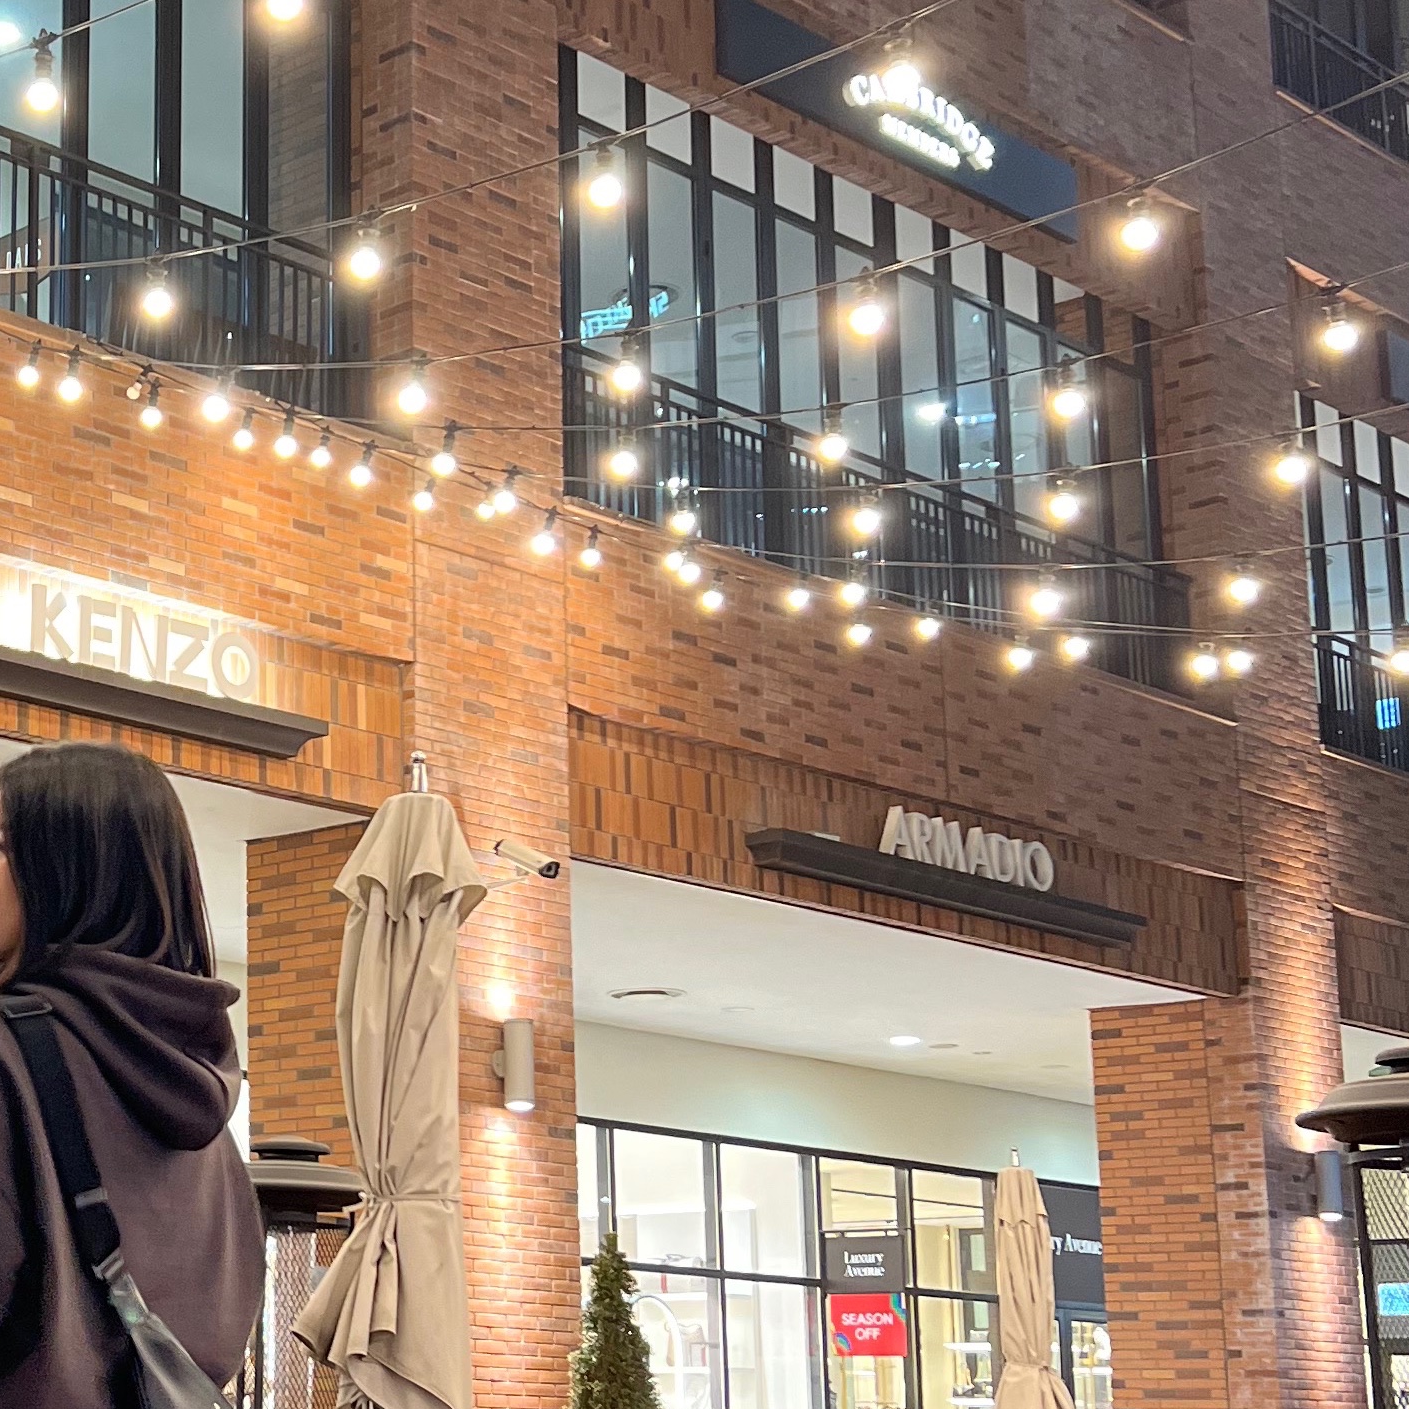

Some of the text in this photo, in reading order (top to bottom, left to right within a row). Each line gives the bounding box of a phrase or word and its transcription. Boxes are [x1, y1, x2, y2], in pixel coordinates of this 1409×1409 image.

[30, 583, 259, 700] KENZO
[878, 804, 1055, 893] ARMADIO
[843, 1250, 885, 1266] Luxury
[843, 1264, 886, 1278] Avenue
[841, 1312, 894, 1326] SEASON
[854, 1327, 882, 1341] OFF
